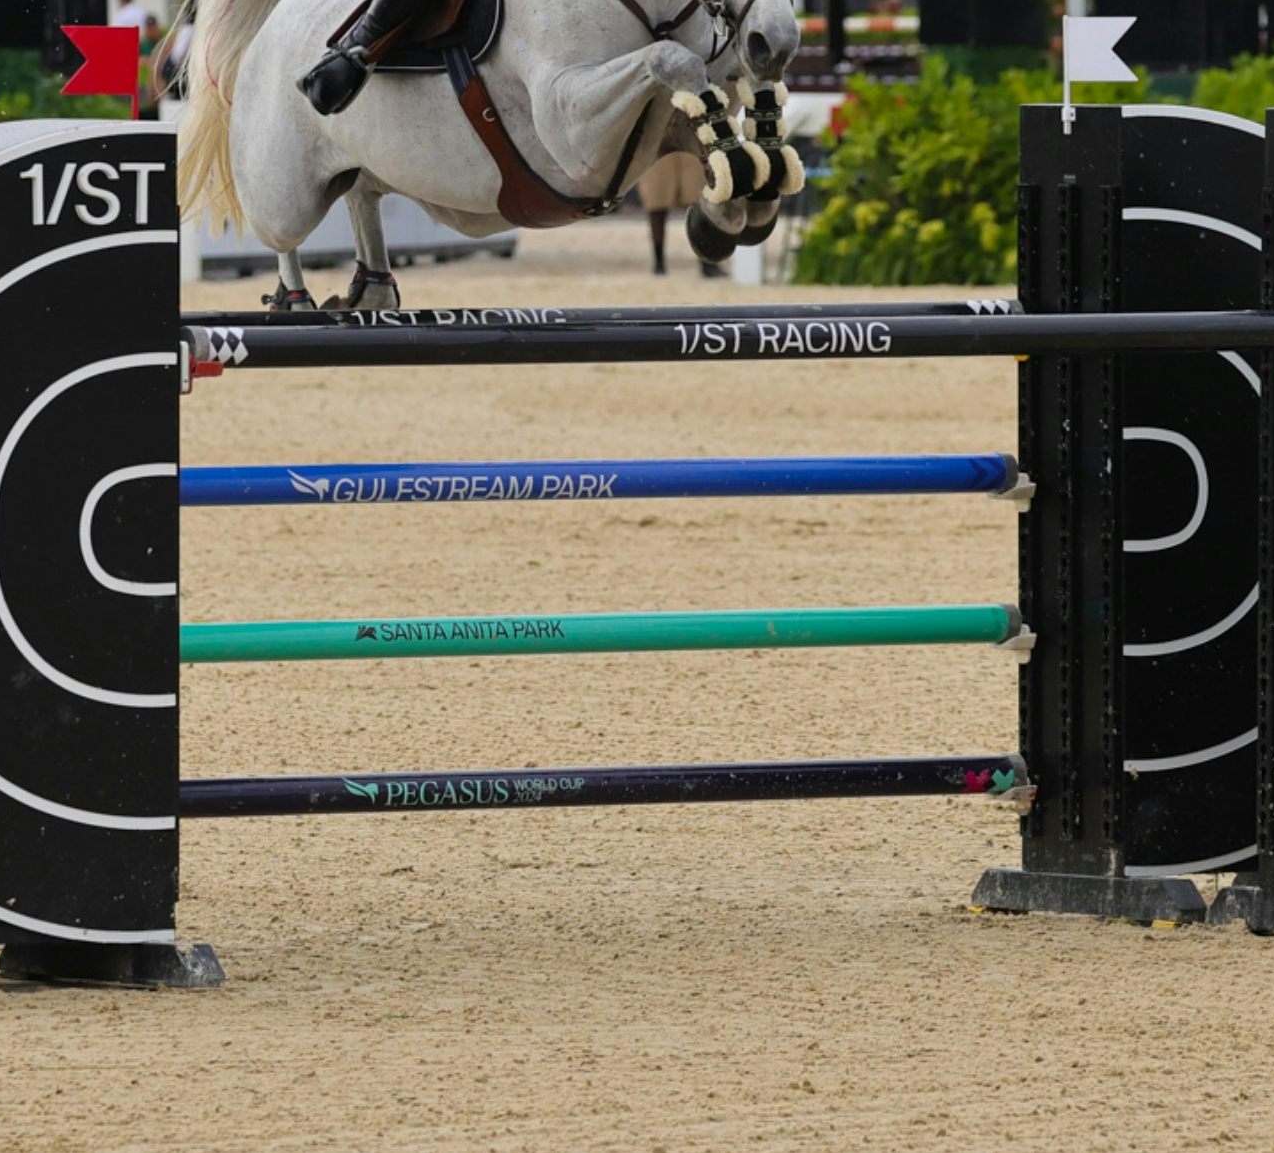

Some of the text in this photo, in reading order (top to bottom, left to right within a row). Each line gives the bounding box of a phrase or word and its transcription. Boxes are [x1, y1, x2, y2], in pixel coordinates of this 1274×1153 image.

[19, 162, 166, 226] 1/ST
[674, 321, 892, 355] 1/ST RACING
[332, 473, 619, 503] GULFSTREAM PARK
[379, 619, 566, 643] SANTA ANITA PARK
[384, 776, 586, 806] PEGASUS WORLD CUP
